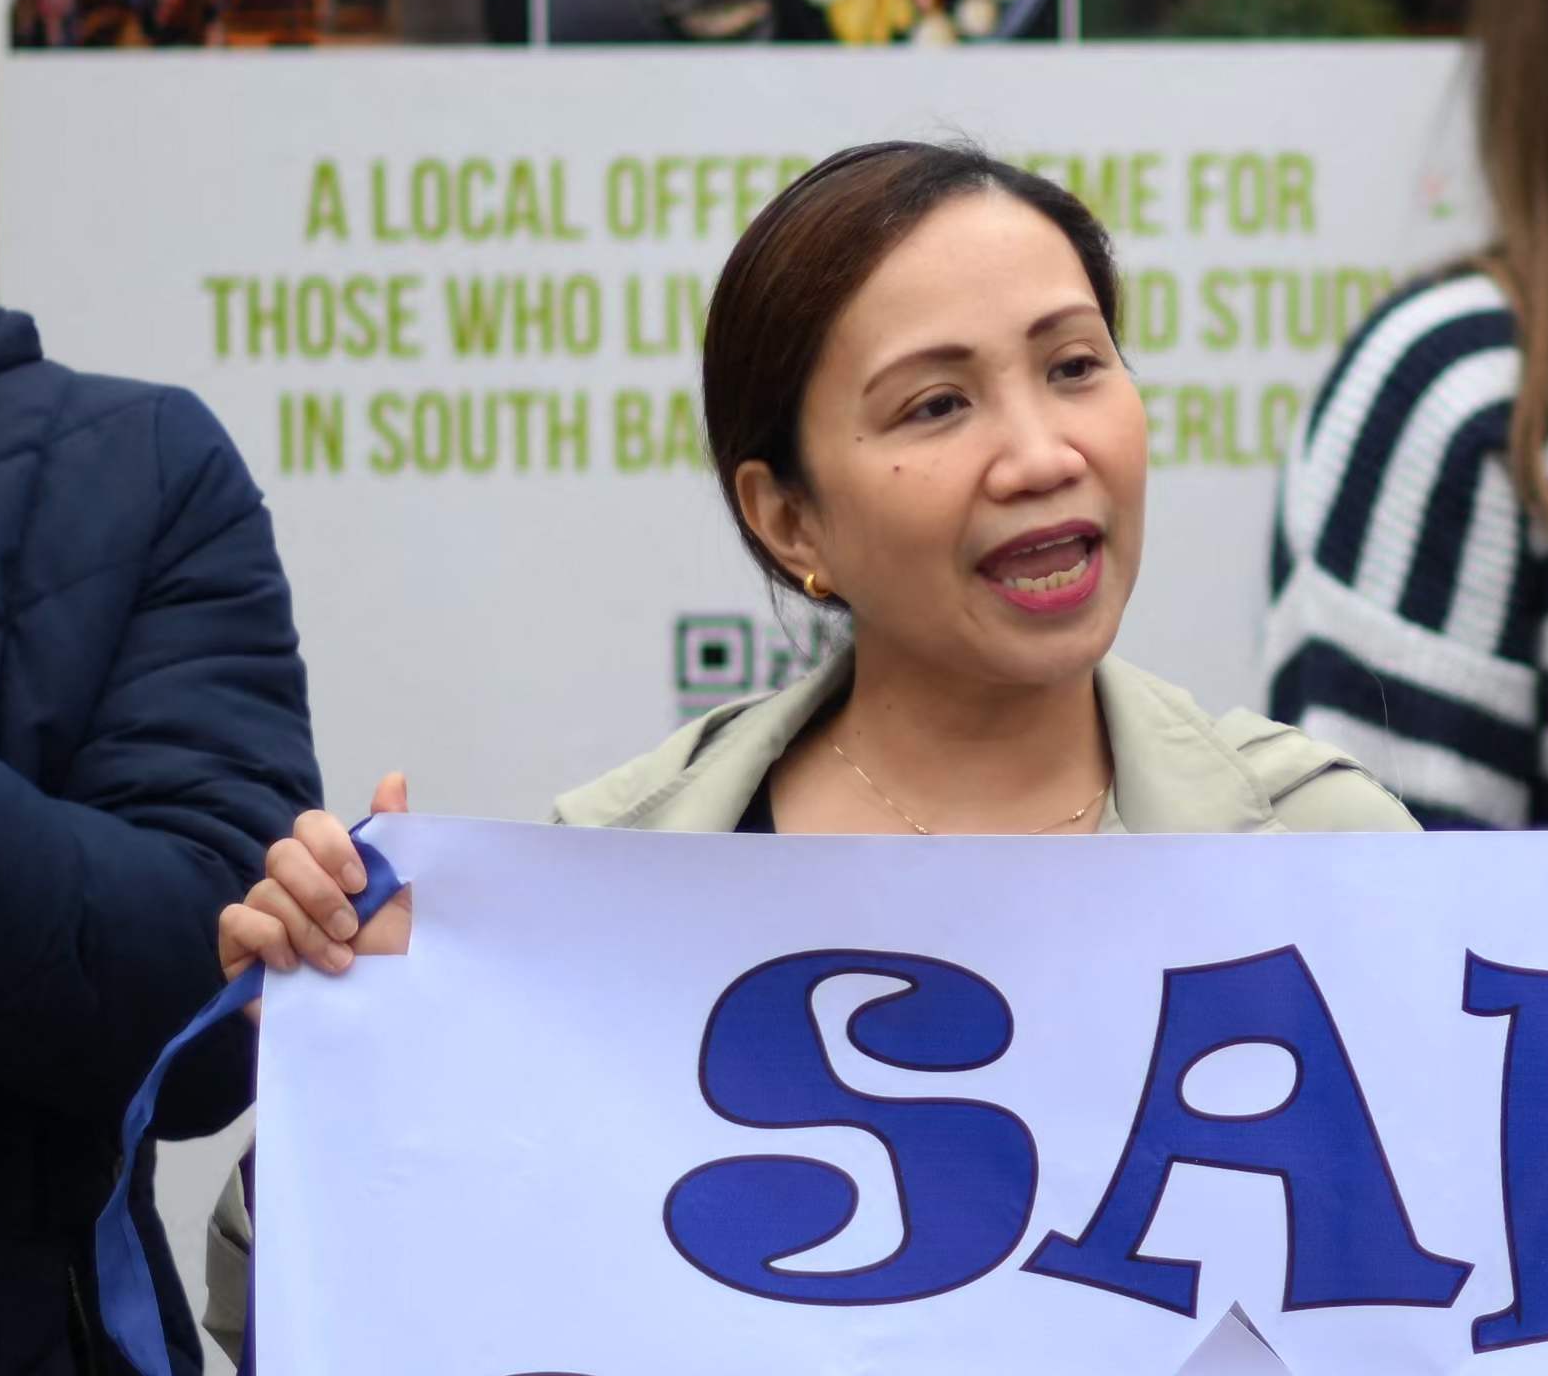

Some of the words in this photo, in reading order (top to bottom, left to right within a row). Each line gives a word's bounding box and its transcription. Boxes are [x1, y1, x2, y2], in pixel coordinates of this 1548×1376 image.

[306, 158, 348, 242] A
[372, 158, 586, 241] LOCAL
[1189, 153, 1315, 235] FOR
[204, 275, 423, 360] THOSE
[444, 274, 602, 358] WHO
[278, 390, 345, 475] IN
[368, 390, 590, 474] SOUTH
